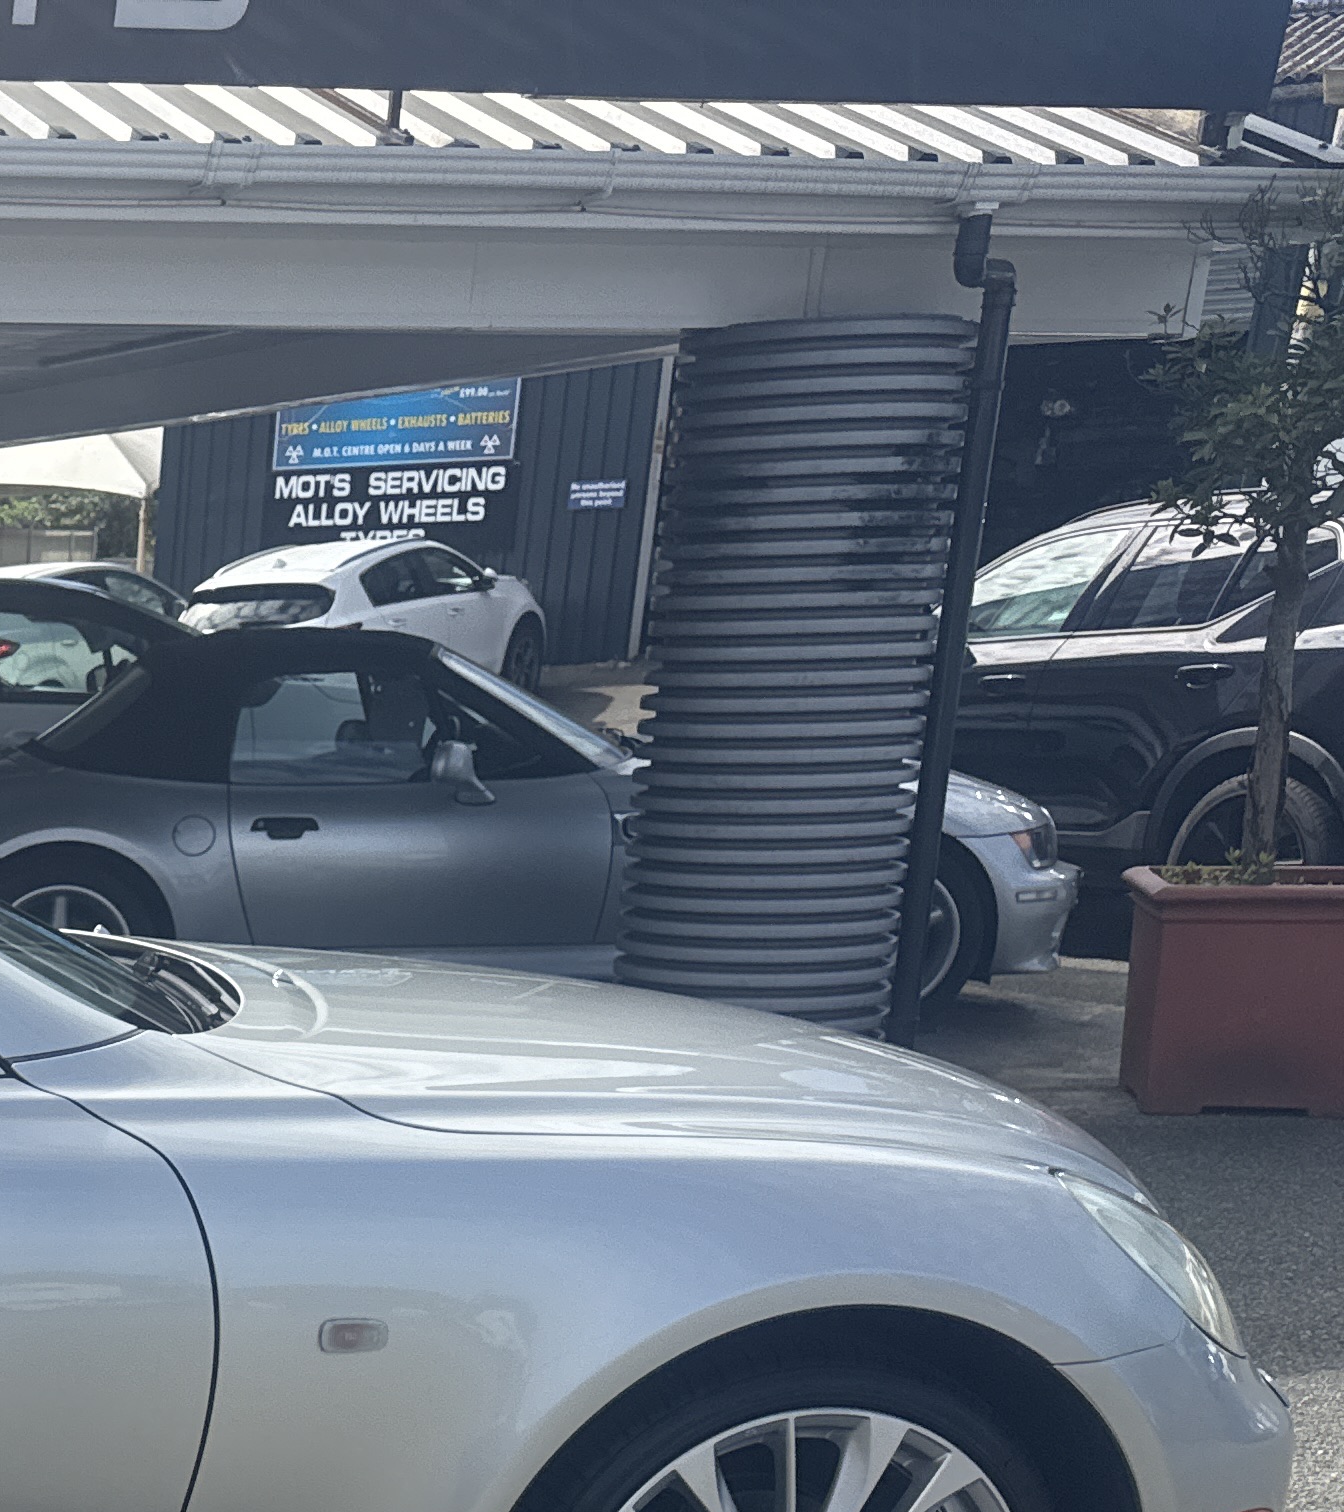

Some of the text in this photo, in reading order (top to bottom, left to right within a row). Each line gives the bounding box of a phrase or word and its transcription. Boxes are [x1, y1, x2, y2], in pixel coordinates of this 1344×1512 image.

[281, 410, 510, 435] TYRES ALLOY WHEELS EXHAUSTS BATTERIES
[342, 444, 375, 457] CENTRE
[377, 442, 402, 455] OPEN
[412, 441, 435, 453] DAYS
[437, 440, 445, 452] A
[447, 439, 472, 451] WEEK
[274, 465, 506, 499] MOT'S SERVICING
[288, 496, 485, 528] ALLOY WHEELS
